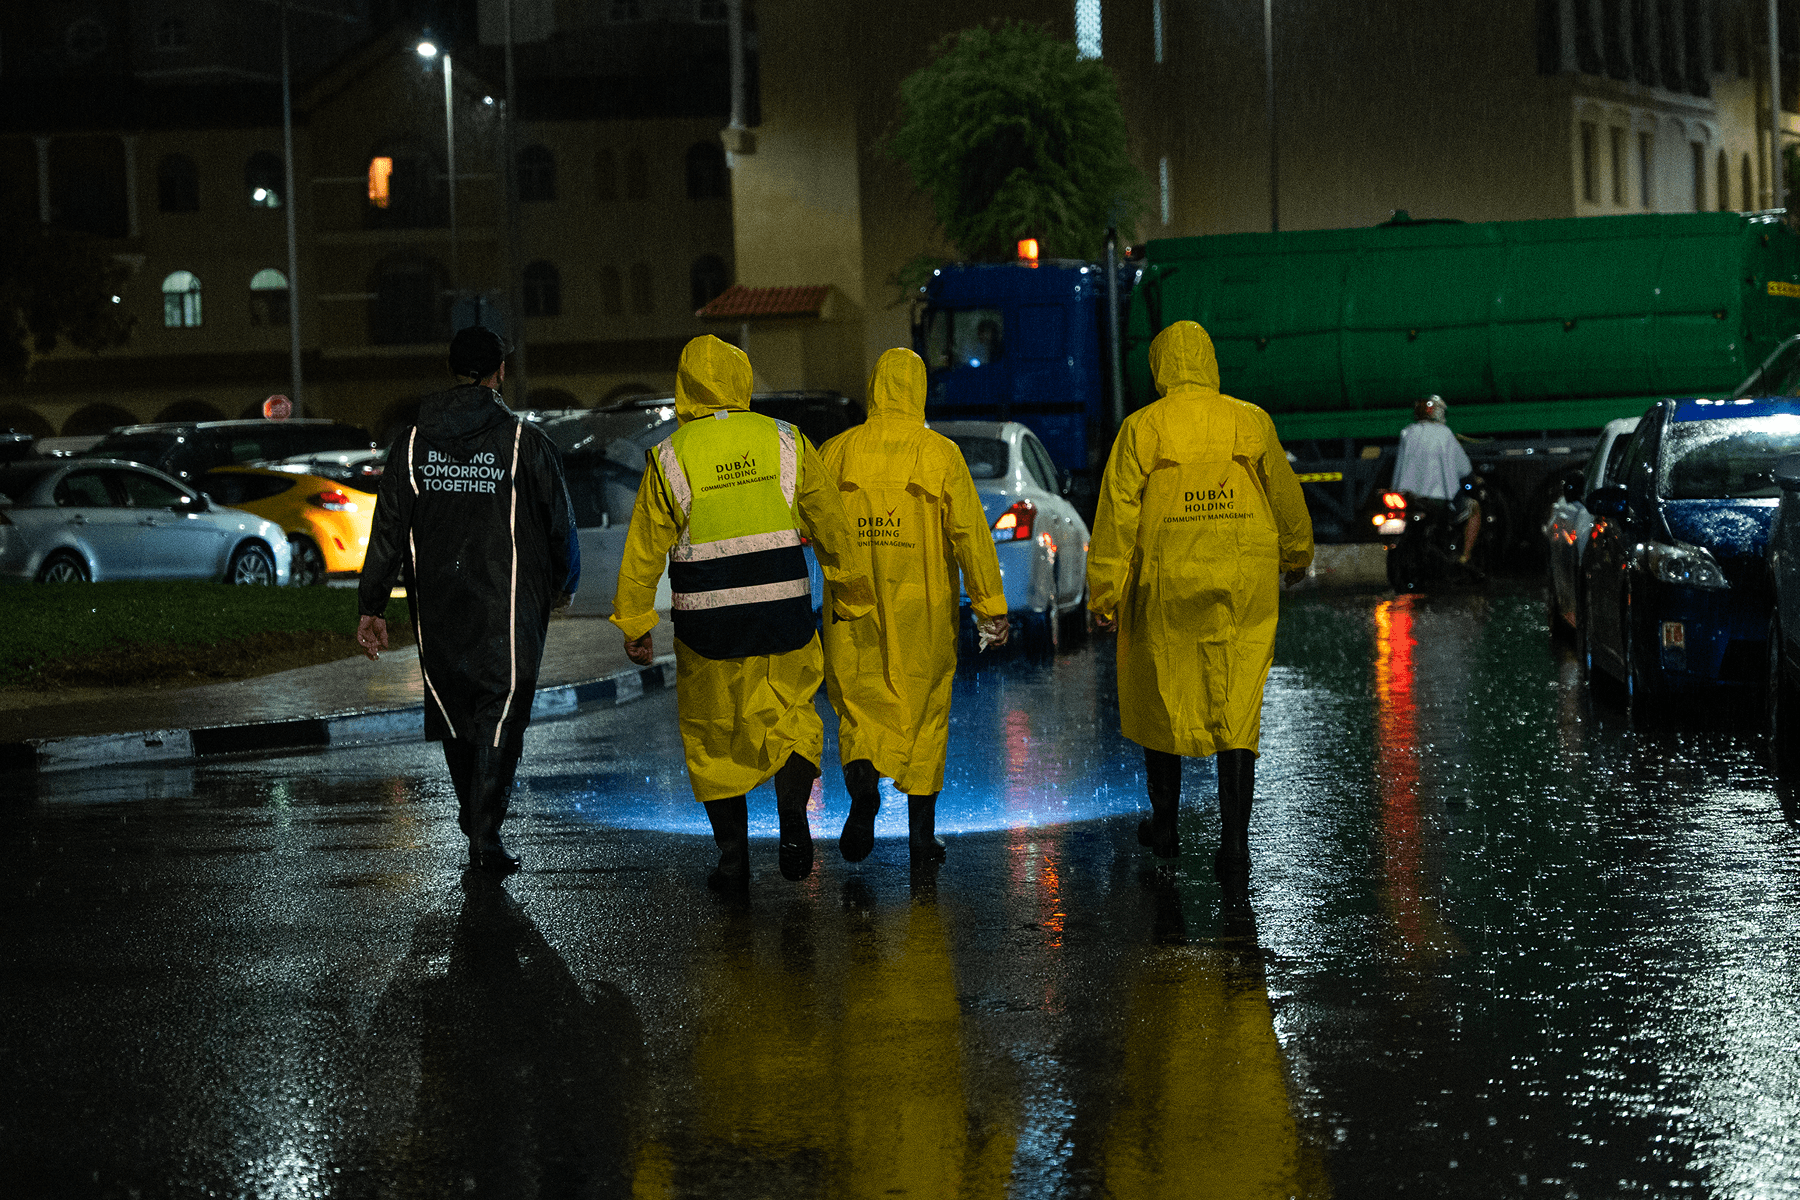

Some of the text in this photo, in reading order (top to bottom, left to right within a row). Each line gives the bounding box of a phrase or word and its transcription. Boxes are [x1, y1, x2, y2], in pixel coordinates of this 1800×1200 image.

[428, 450, 495, 465] BUILNG
[418, 464, 505, 481] TOMORROW
[716, 458, 756, 473] DUBAI
[717, 468, 757, 481] HOLDING
[423, 478, 496, 494] TOGETHER
[700, 474, 777, 492] COMMUNITY MANAGEMENT
[1184, 488, 1234, 502] DUBAI
[1185, 501, 1234, 513] HOLDING
[1163, 512, 1254, 523] COMMUNITY MANAGEMENT
[858, 529, 900, 538] HODING
